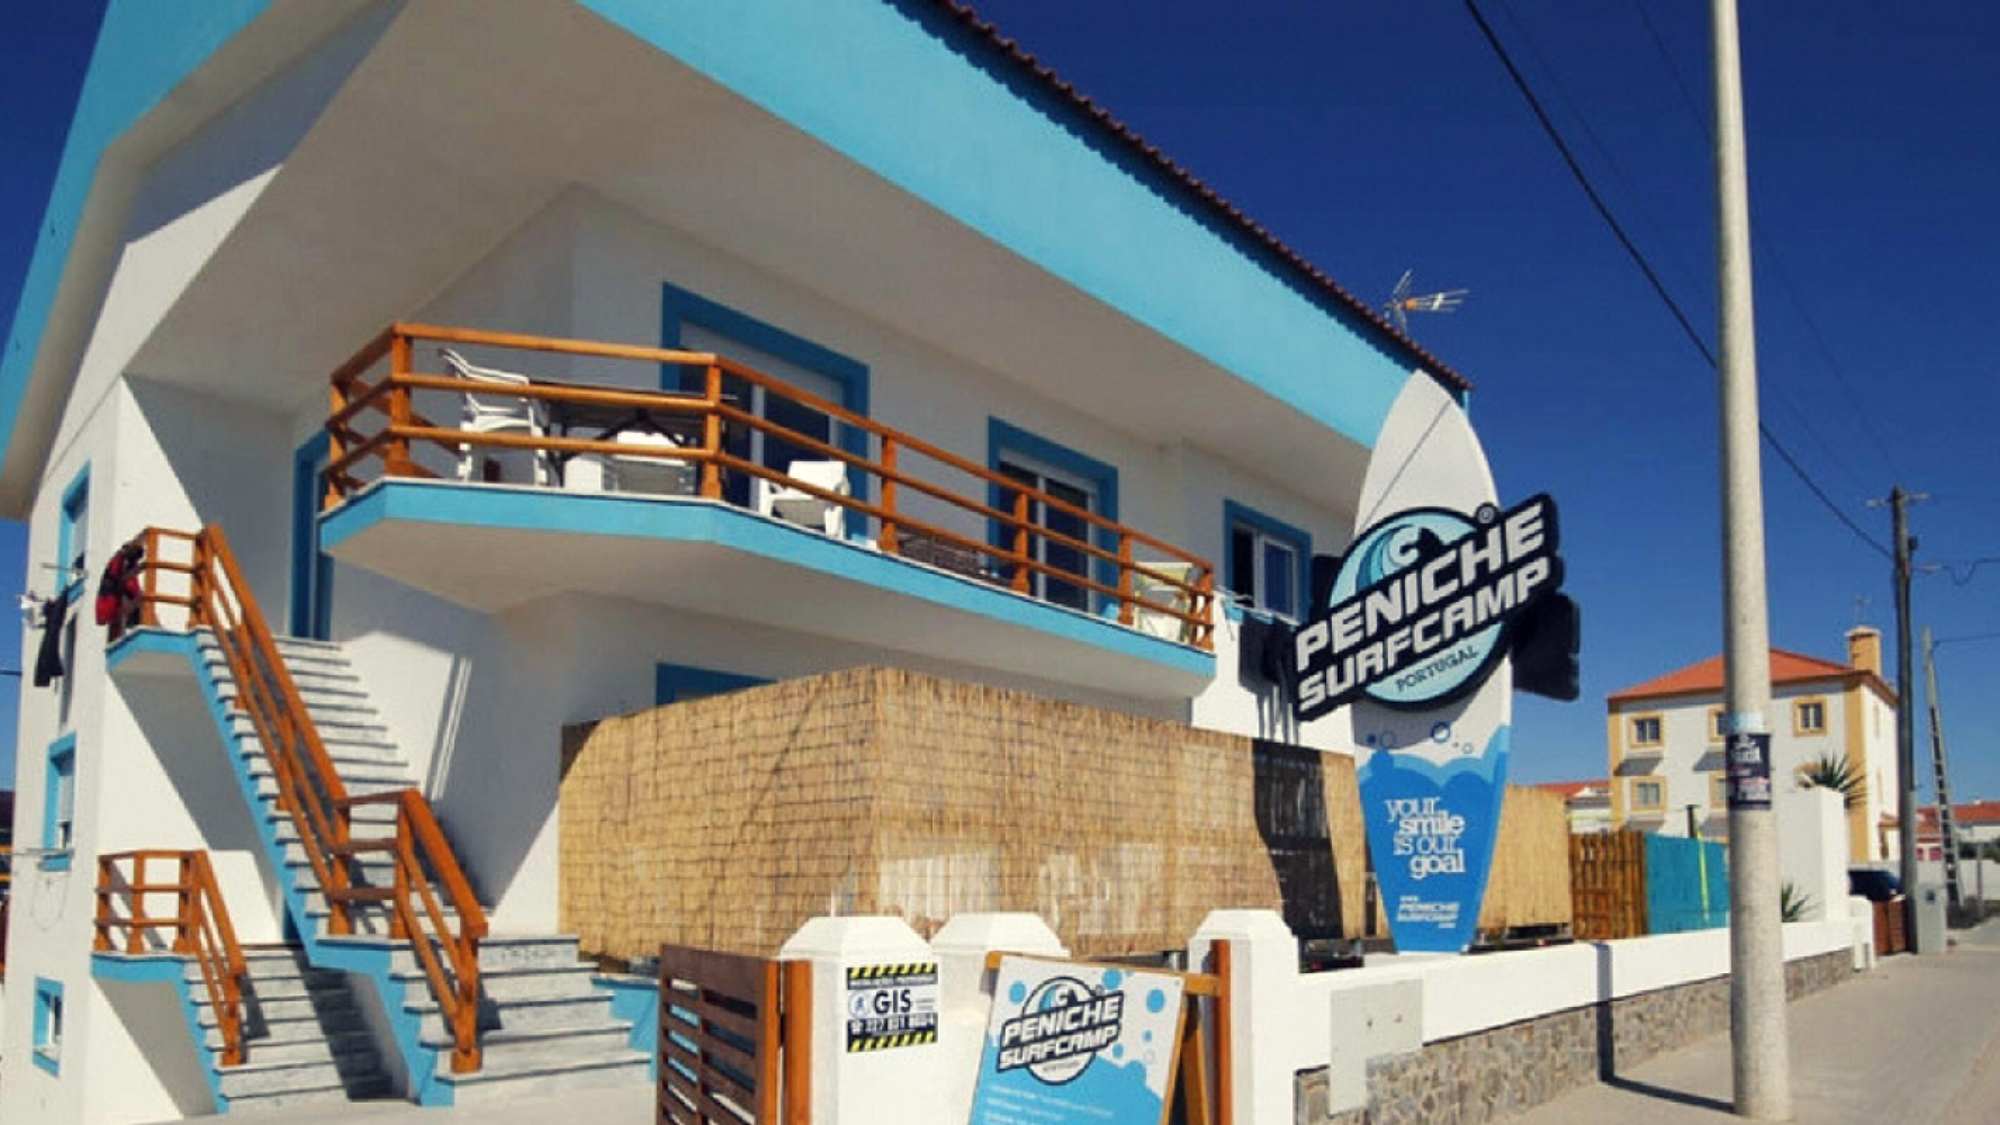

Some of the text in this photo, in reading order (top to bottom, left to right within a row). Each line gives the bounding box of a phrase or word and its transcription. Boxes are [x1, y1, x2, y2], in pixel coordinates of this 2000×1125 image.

[1296, 502, 1545, 672] PENICHE
[1299, 556, 1550, 712] SURFCAMP
[1395, 645, 1478, 691] PORTUGAL
[1385, 797, 1440, 823] your
[1399, 810, 1466, 836] smile
[1393, 831, 1460, 855] is our
[1410, 848, 1466, 880] goal
[873, 989, 912, 1015] GIS
[1002, 996, 1121, 1048] PENICHE
[999, 1024, 1119, 1070] SURFCAMP
